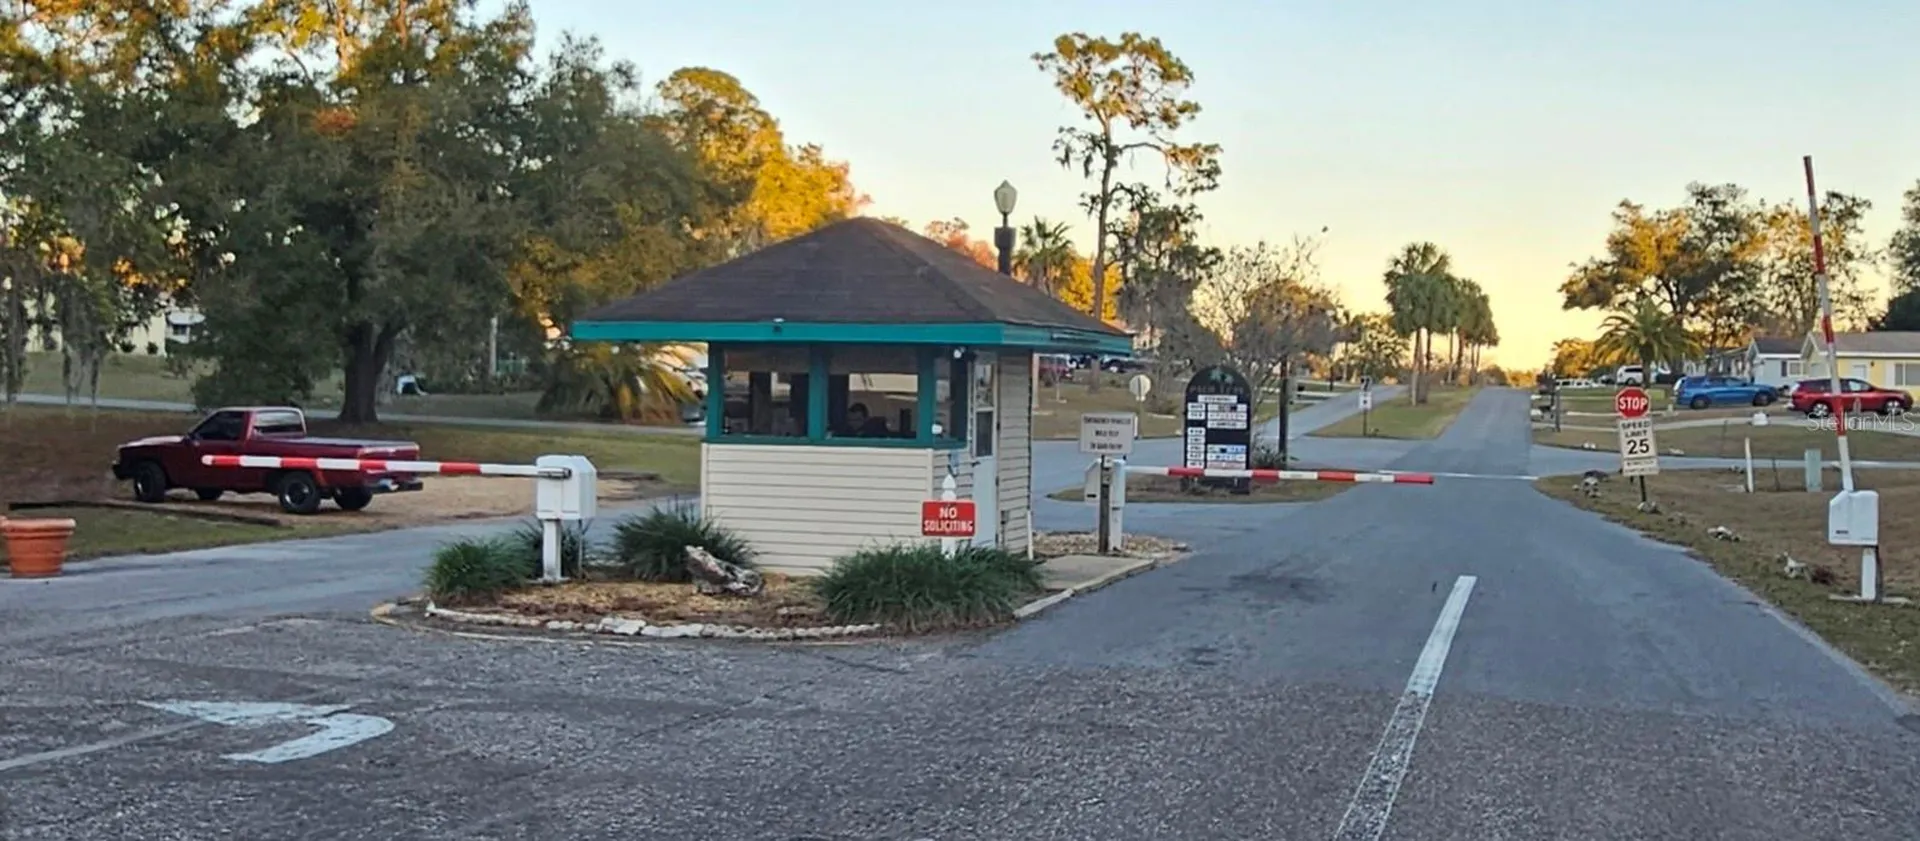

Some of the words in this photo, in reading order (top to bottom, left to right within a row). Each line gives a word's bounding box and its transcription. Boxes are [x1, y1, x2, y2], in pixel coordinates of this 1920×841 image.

[1619, 396, 1648, 410] STOP
[1621, 420, 1651, 429] SPEED
[1627, 438, 1650, 455] 25
[939, 507, 957, 519] NO
[924, 520, 973, 532] SOLICITING
